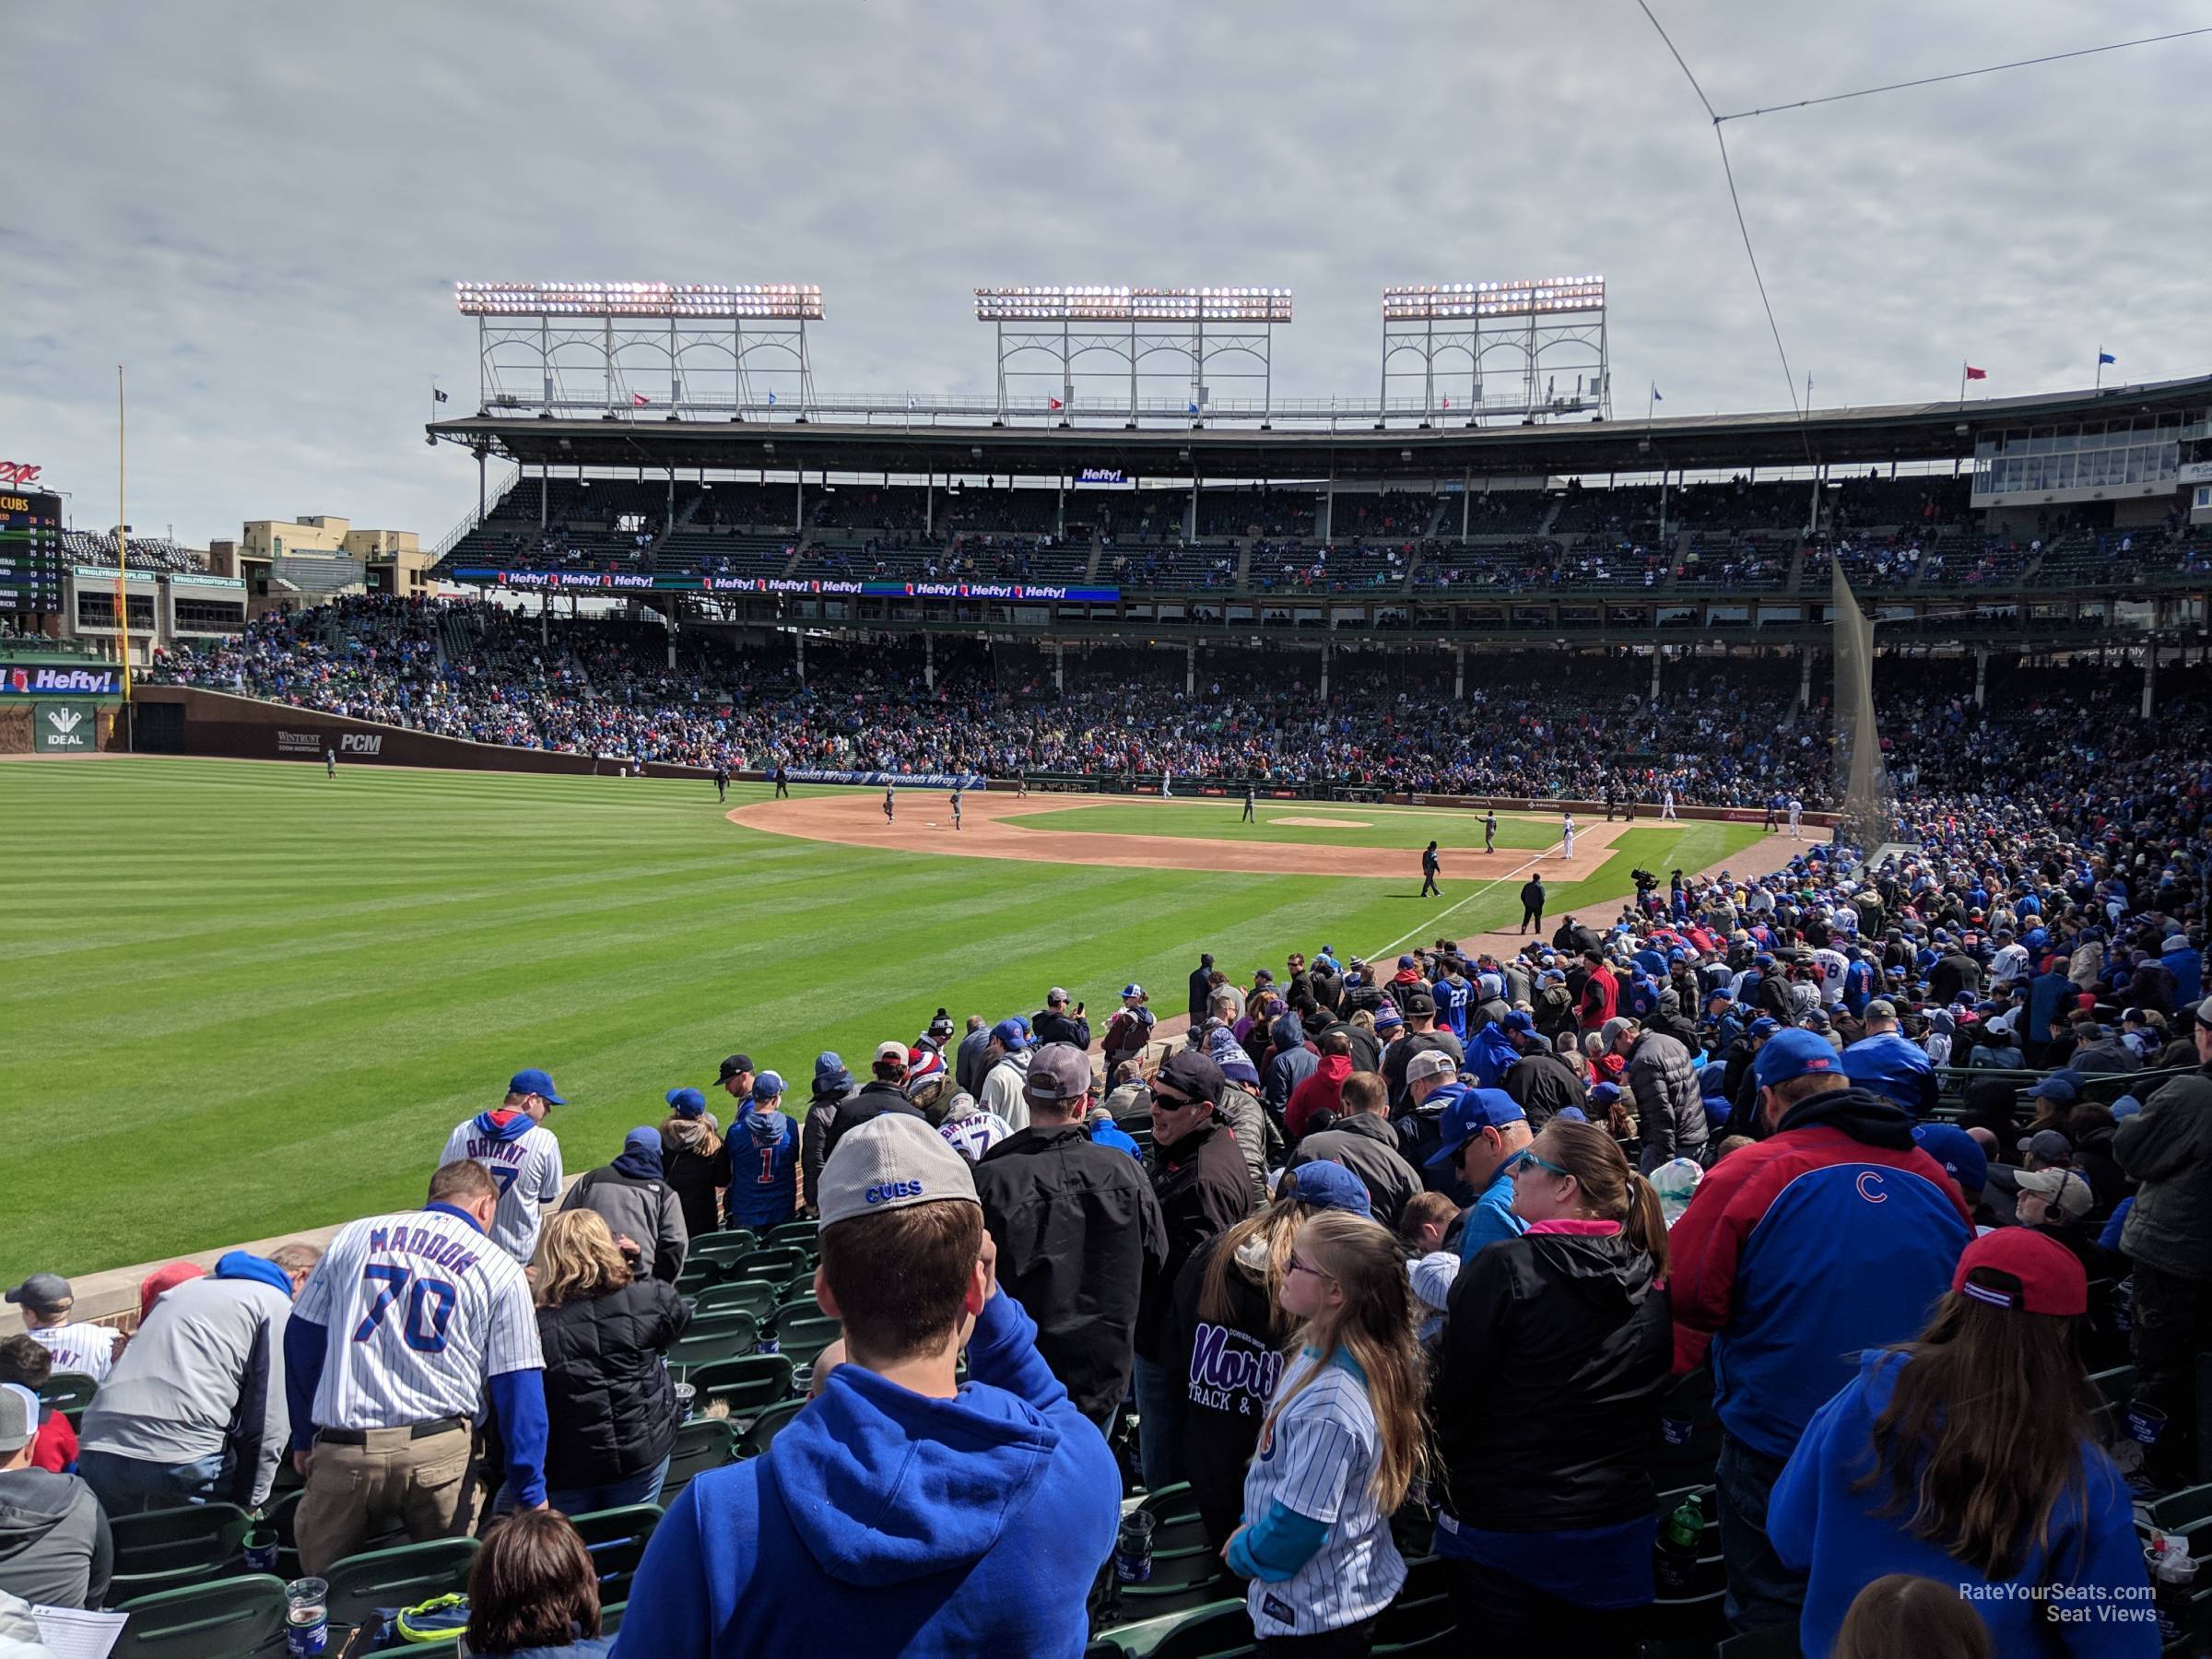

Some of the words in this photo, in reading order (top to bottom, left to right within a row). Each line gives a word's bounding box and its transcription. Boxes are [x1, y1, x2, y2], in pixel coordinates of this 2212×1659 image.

[1082, 468, 1122, 481] Hefty!
[1, 497, 29, 512] CUBS
[77, 567, 152, 581] WRIGLEYROOFOPS.COM
[510, 573, 548, 584] Hefty!
[562, 574, 601, 586] Hefty!
[614, 575, 653, 587] Hefty!
[715, 578, 755, 590] Hefty!
[769, 580, 808, 592] Hefty!
[822, 582, 863, 593] Hefty!
[917, 583, 957, 595] Hefty!
[971, 585, 1011, 597] Hefty!
[1026, 587, 1066, 598] Hefty!
[36, 669, 112, 692] Hefty!
[48, 735, 84, 745] IDEAL
[340, 734, 382, 752] PCM
[784, 769, 824, 781] eynolds
[823, 771, 853, 782] Wrap
[877, 772, 928, 783] Reynolds
[926, 774, 957, 786] Wrap
[1450, 988, 1468, 1007] 23
[940, 1114, 990, 1139] BRYANT
[466, 1135, 528, 1166] BRYANT
[757, 1147, 775, 1184] 1
[865, 1180, 924, 1204] CUBS
[370, 1226, 481, 1277] MADDON
[353, 1264, 457, 1354] 70
[1188, 1382, 1232, 1411] TRACK
[1239, 1396, 1251, 1416] &
